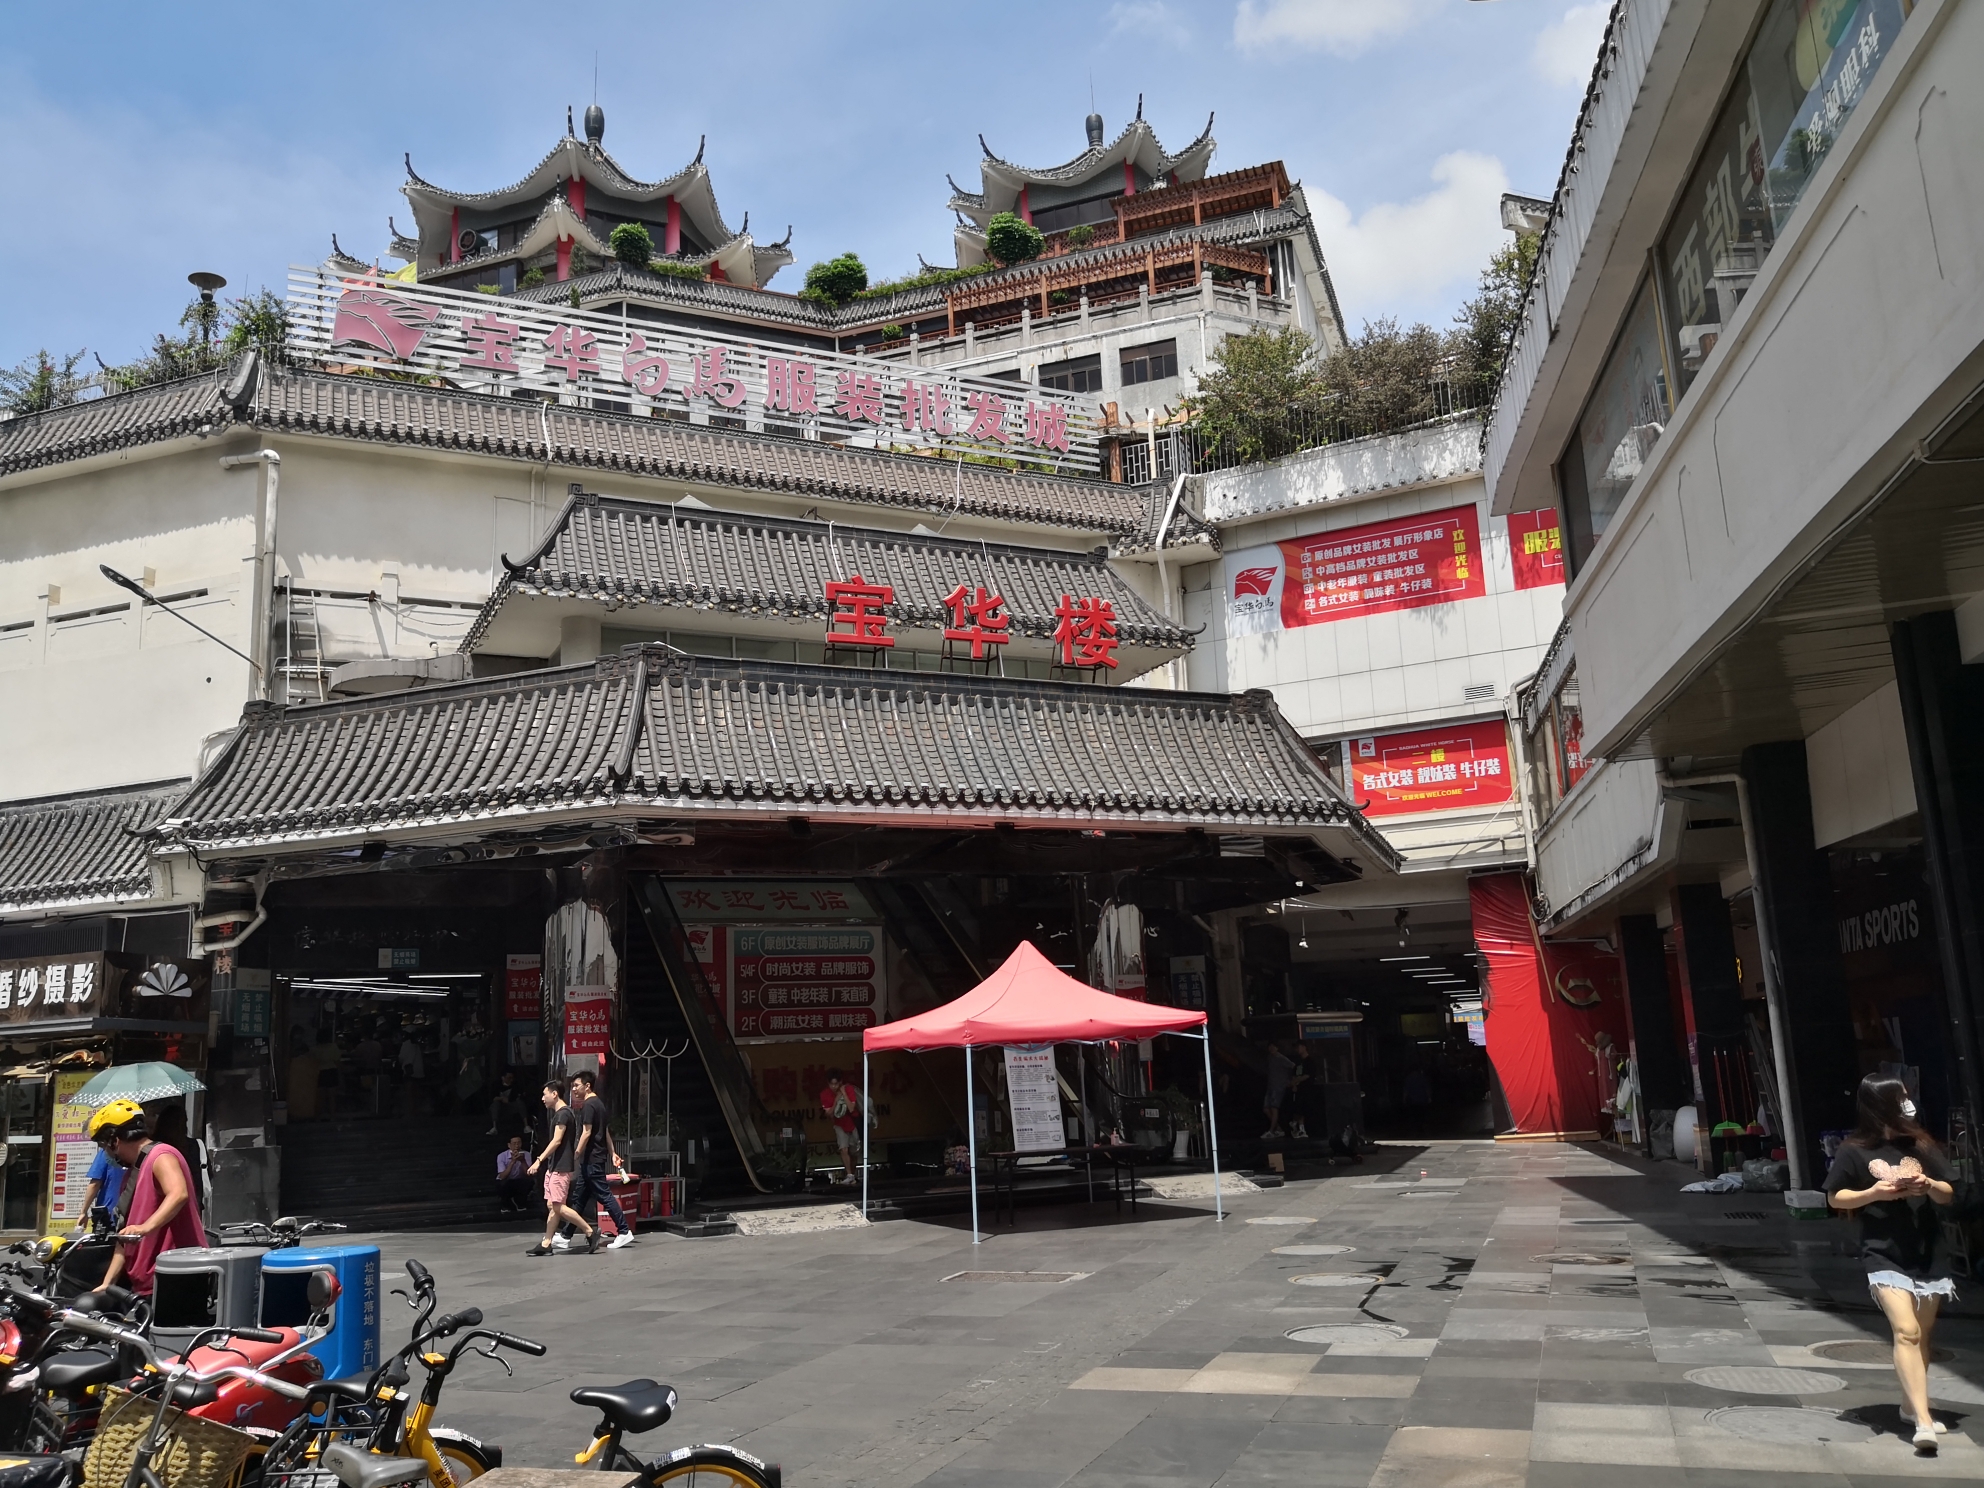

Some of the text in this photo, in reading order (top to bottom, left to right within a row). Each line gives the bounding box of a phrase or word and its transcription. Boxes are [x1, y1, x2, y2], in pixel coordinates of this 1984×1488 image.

[1314, 538, 1392, 561] 原创品牌女装批发
[1394, 528, 1444, 547] 展厅形象店
[1452, 529, 1469, 579] 欢迎光临
[1315, 548, 1419, 577] 中高档品牌女装批发区
[1317, 573, 1369, 592] 中老年服装
[1373, 562, 1426, 583] 童装批发区
[1319, 590, 1360, 607] 各式女装
[1363, 584, 1396, 600] 靓妹装
[1400, 578, 1433, 593] 牛仔装
[824, 574, 1120, 671] 宝华楼
[1412, 748, 1446, 765] 二楼
[1362, 757, 1501, 791] 各式女装 靓妹装 牛仔装
[1425, 788, 1463, 799] WELCOME
[676, 889, 850, 912] 欢迎光临
[1864, 899, 1919, 948] SPORTS
[741, 936, 870, 951] 6F 原创女装服饰品牌展厅
[765, 962, 816, 976] 时尚女装
[820, 961, 870, 975] 品牌服饰
[0, 963, 94, 1009] 婚纱摄影
[741, 986, 869, 1004] 3F 童装 中老年装 厂家直销
[567, 1024, 608, 1034] 服装批发城
[741, 1013, 868, 1031] 2F 潮流女装 靓妹装
[363, 1261, 375, 1326] 垃圾不落地
